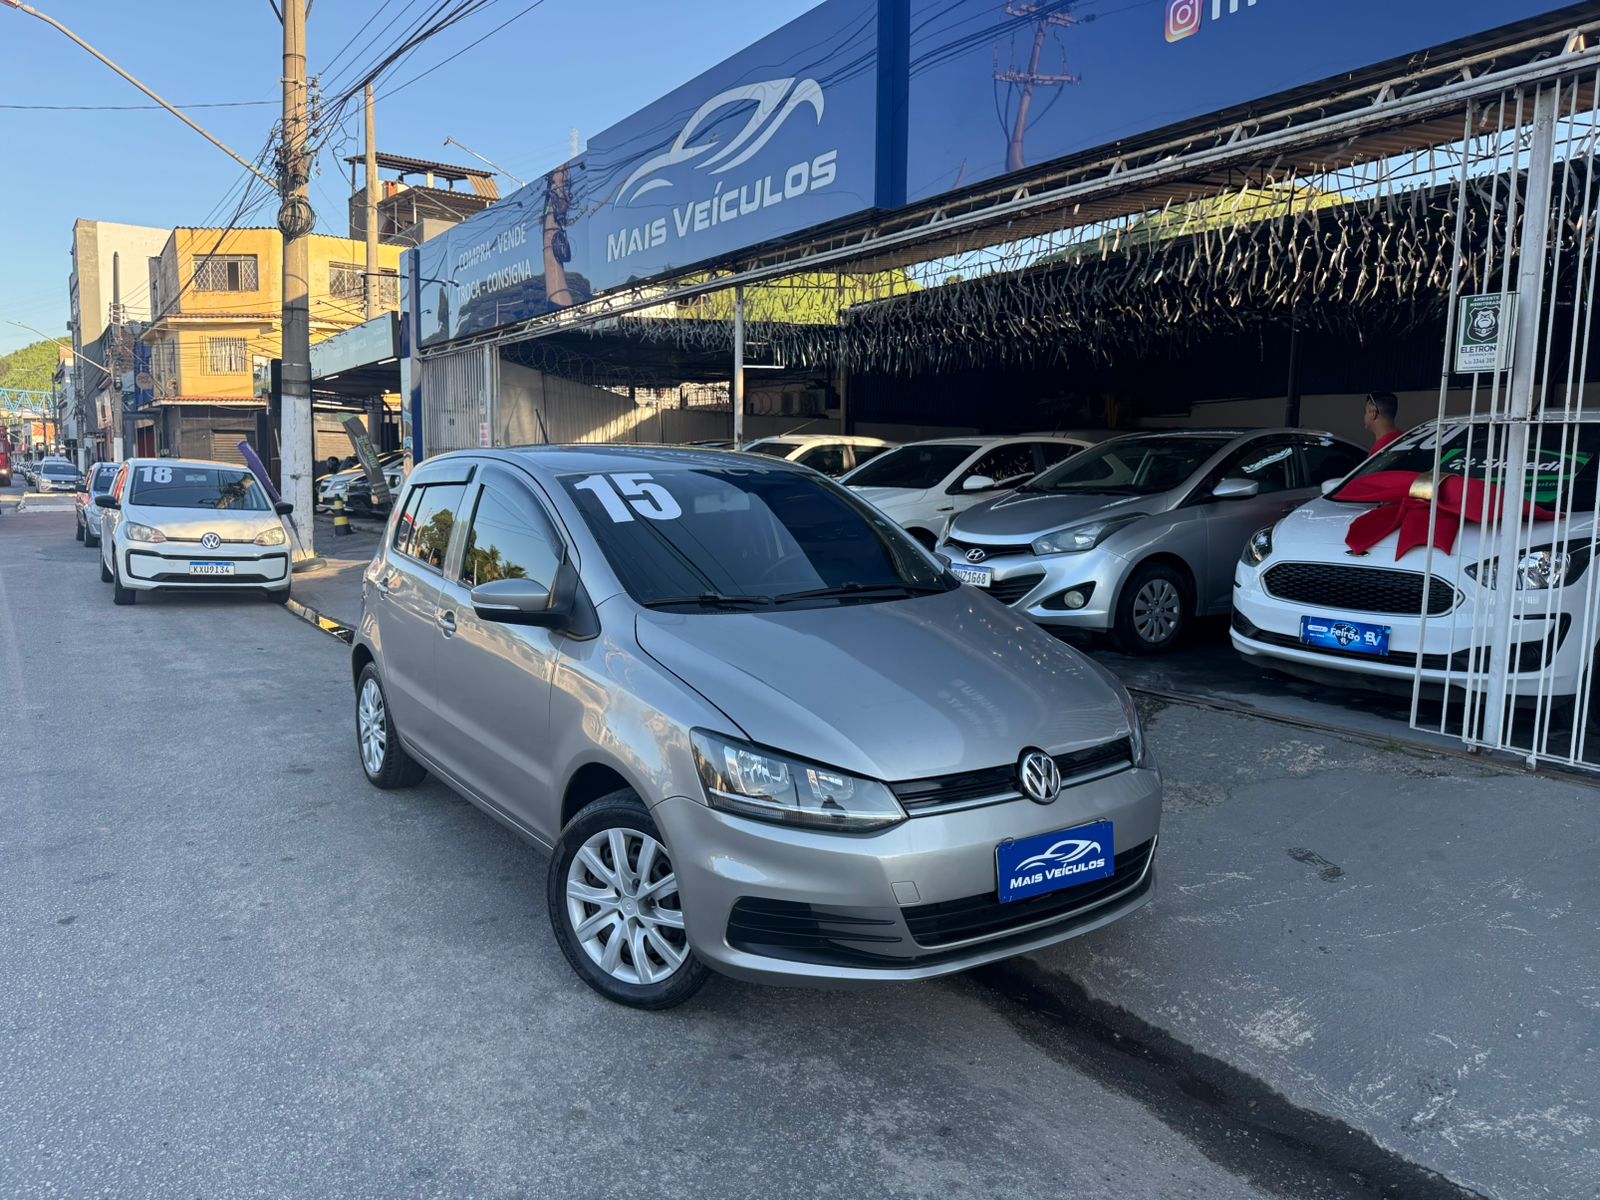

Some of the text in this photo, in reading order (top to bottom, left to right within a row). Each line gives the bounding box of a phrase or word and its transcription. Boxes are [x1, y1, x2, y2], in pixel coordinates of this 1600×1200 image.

[607, 149, 838, 263] MAIS VEÍCULOS
[458, 241, 492, 272] COMPRA
[496, 223, 527, 254] VENDE
[456, 279, 482, 305] TROCA
[486, 258, 532, 293] CONSIGNA
[1460, 344, 1497, 354] ELETRON
[139, 466, 173, 484] 18
[574, 472, 682, 524] 15
[1330, 626, 1360, 642] Feirão
[1009, 858, 1106, 890] MAIS VEÍCULOS
